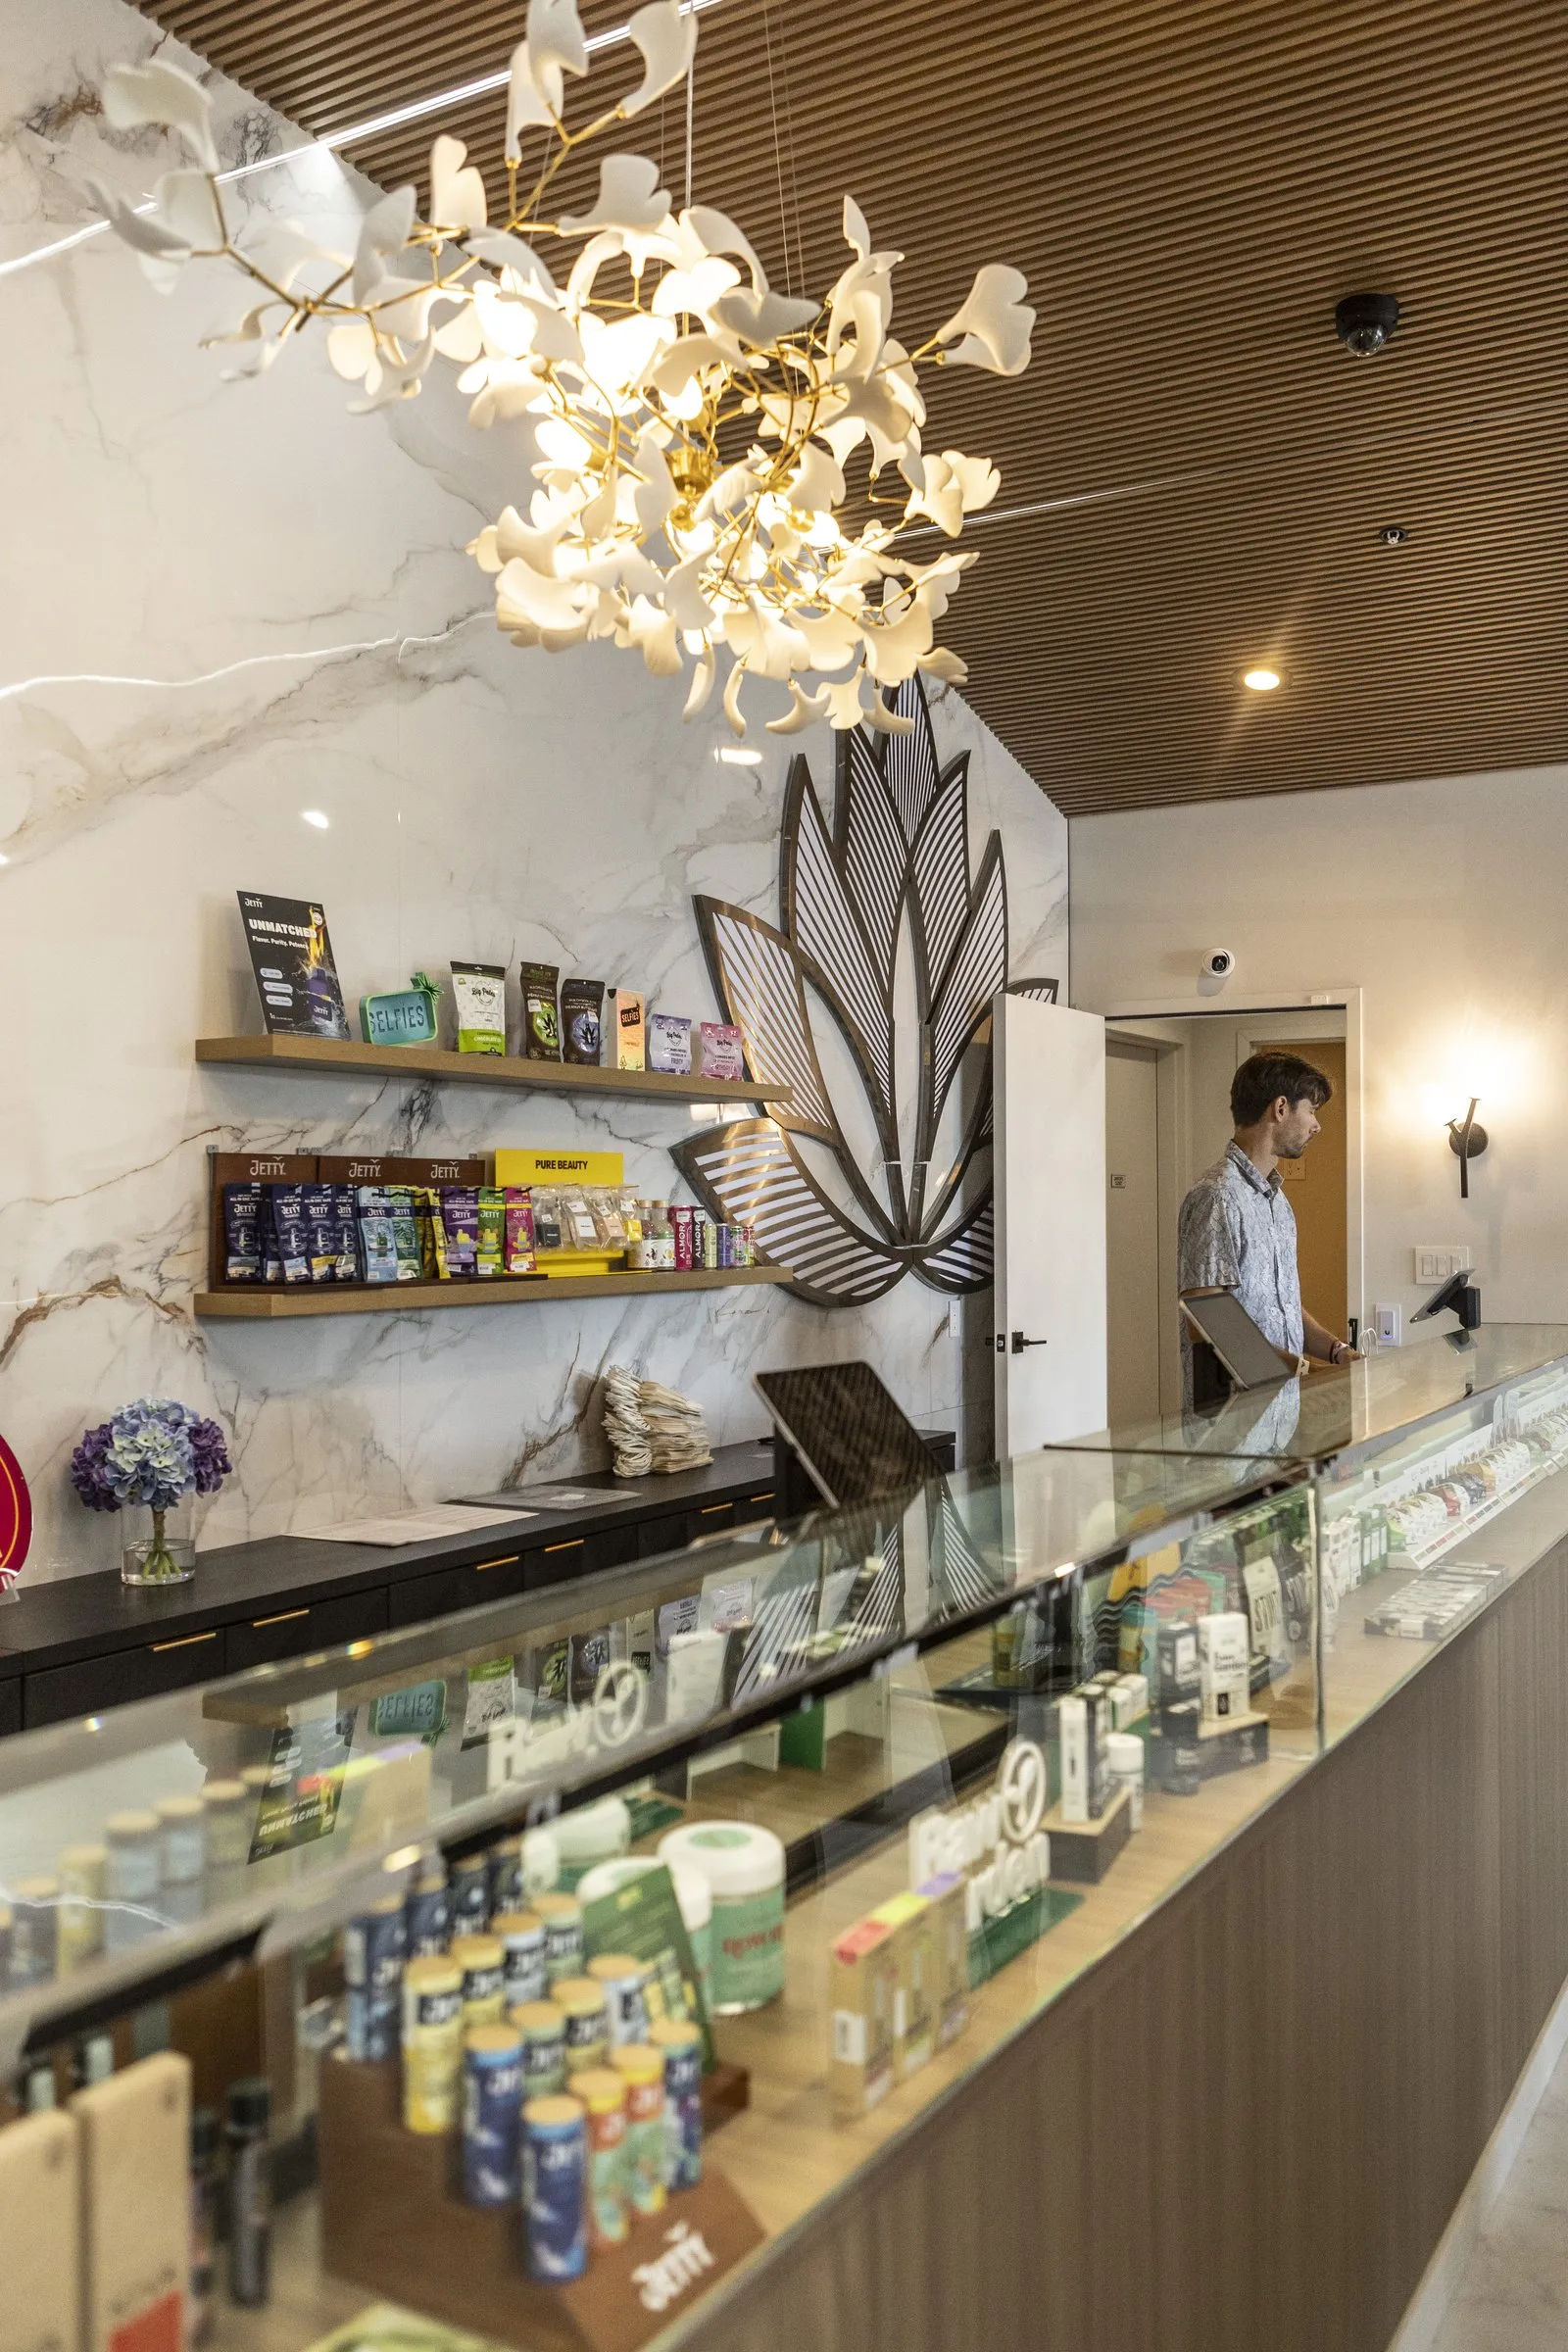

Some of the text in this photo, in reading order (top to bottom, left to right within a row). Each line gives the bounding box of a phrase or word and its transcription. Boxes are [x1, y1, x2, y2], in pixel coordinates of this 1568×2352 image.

[248, 918, 318, 939] UNMATCHED
[368, 1004, 424, 1034] SELFIES
[621, 1010, 639, 1023] SELFIES
[250, 1156, 285, 1176] JETTY
[349, 1158, 380, 1177] JETTY
[431, 1161, 460, 1179] JETTY
[535, 1160, 588, 1170] PURE BEAUTY
[234, 1203, 257, 1213] JETTY
[280, 1203, 301, 1215] JETTY
[309, 1203, 328, 1214] JETTY
[452, 1209, 471, 1218] JETTY
[480, 1209, 500, 1218] JETTY
